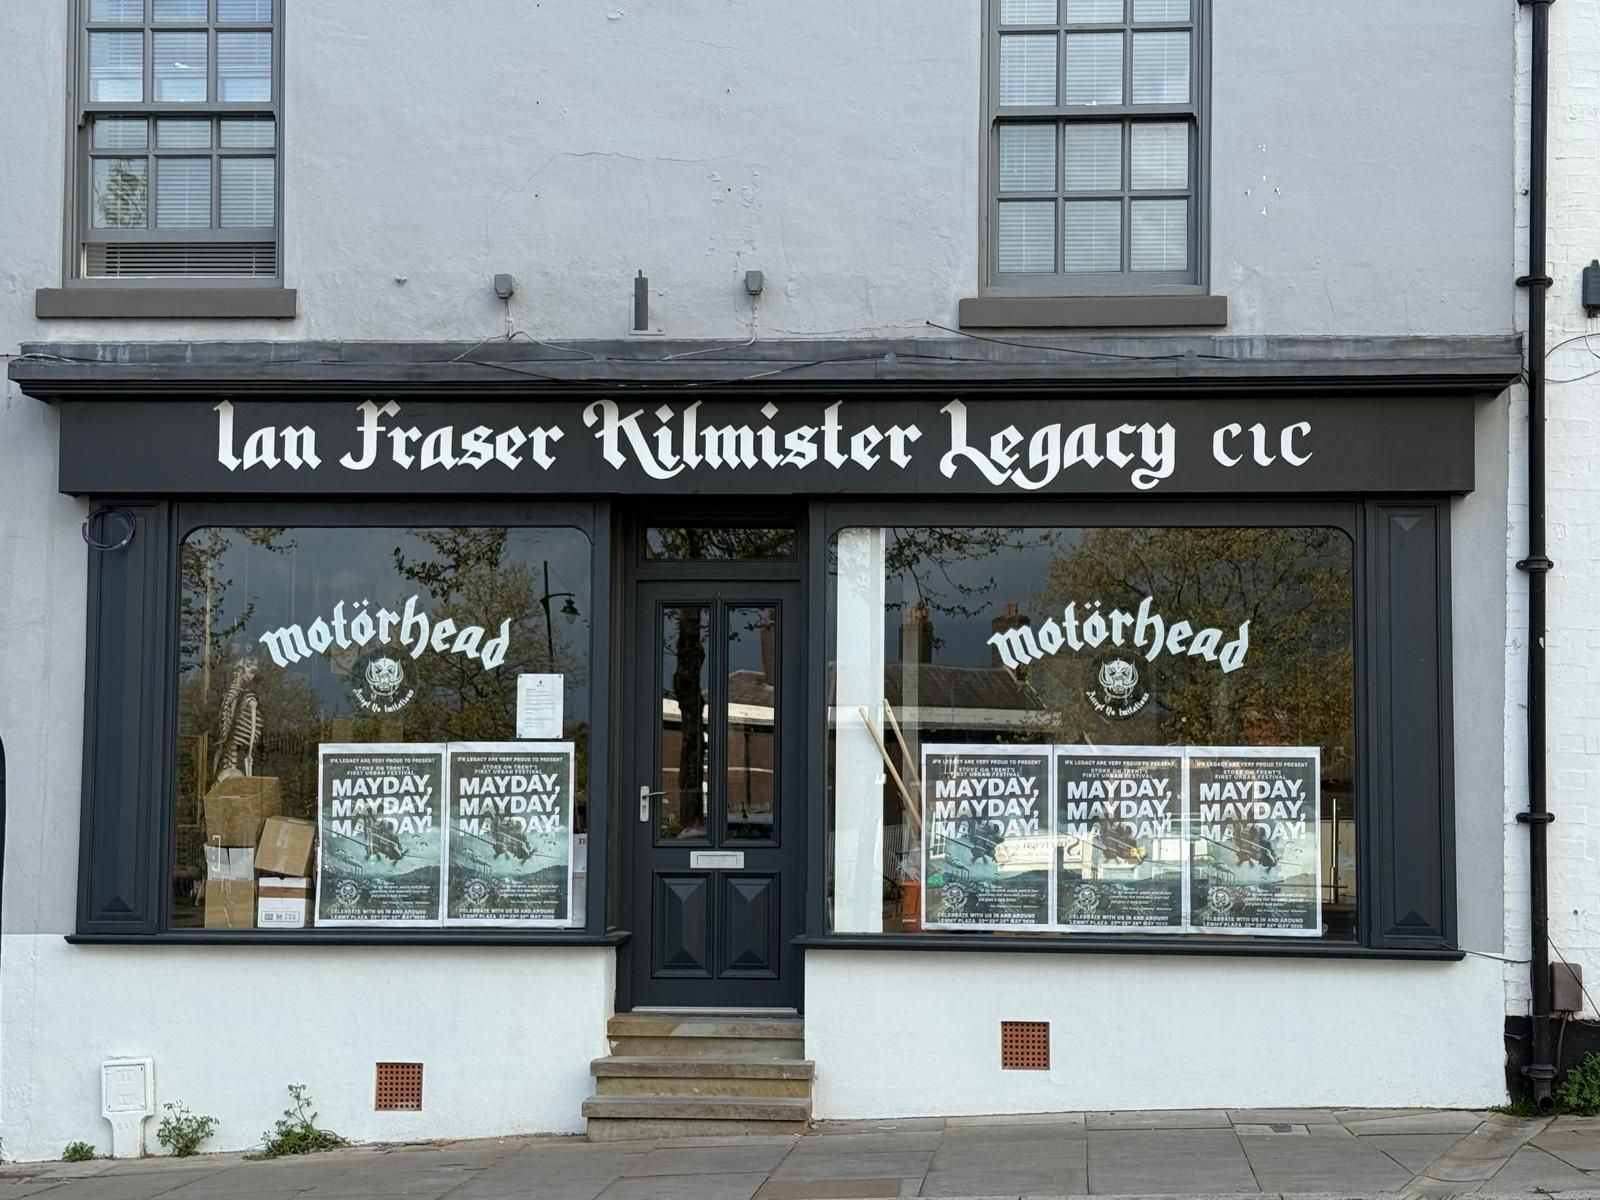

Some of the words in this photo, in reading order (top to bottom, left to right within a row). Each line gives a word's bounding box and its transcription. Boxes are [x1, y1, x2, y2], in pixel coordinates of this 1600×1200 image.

[214, 399, 322, 471] Ian
[339, 399, 564, 471] Fraser
[583, 399, 922, 480] Kilmister
[940, 398, 1176, 490] Legacy
[332, 776, 433, 797] MAYDAY,
[460, 775, 560, 795] MAYDAY,
[936, 777, 1039, 799] MAYDAY,
[1067, 778, 1172, 800] MAYDAY,
[1200, 780, 1306, 802] MAYDAY,
[332, 796, 432, 817] MAYDAY,
[460, 795, 560, 815] MAYDAY,
[936, 798, 1039, 819] MAYDAY,
[1068, 799, 1172, 821] MAYDAY,
[1200, 801, 1306, 822] MAYDAY,
